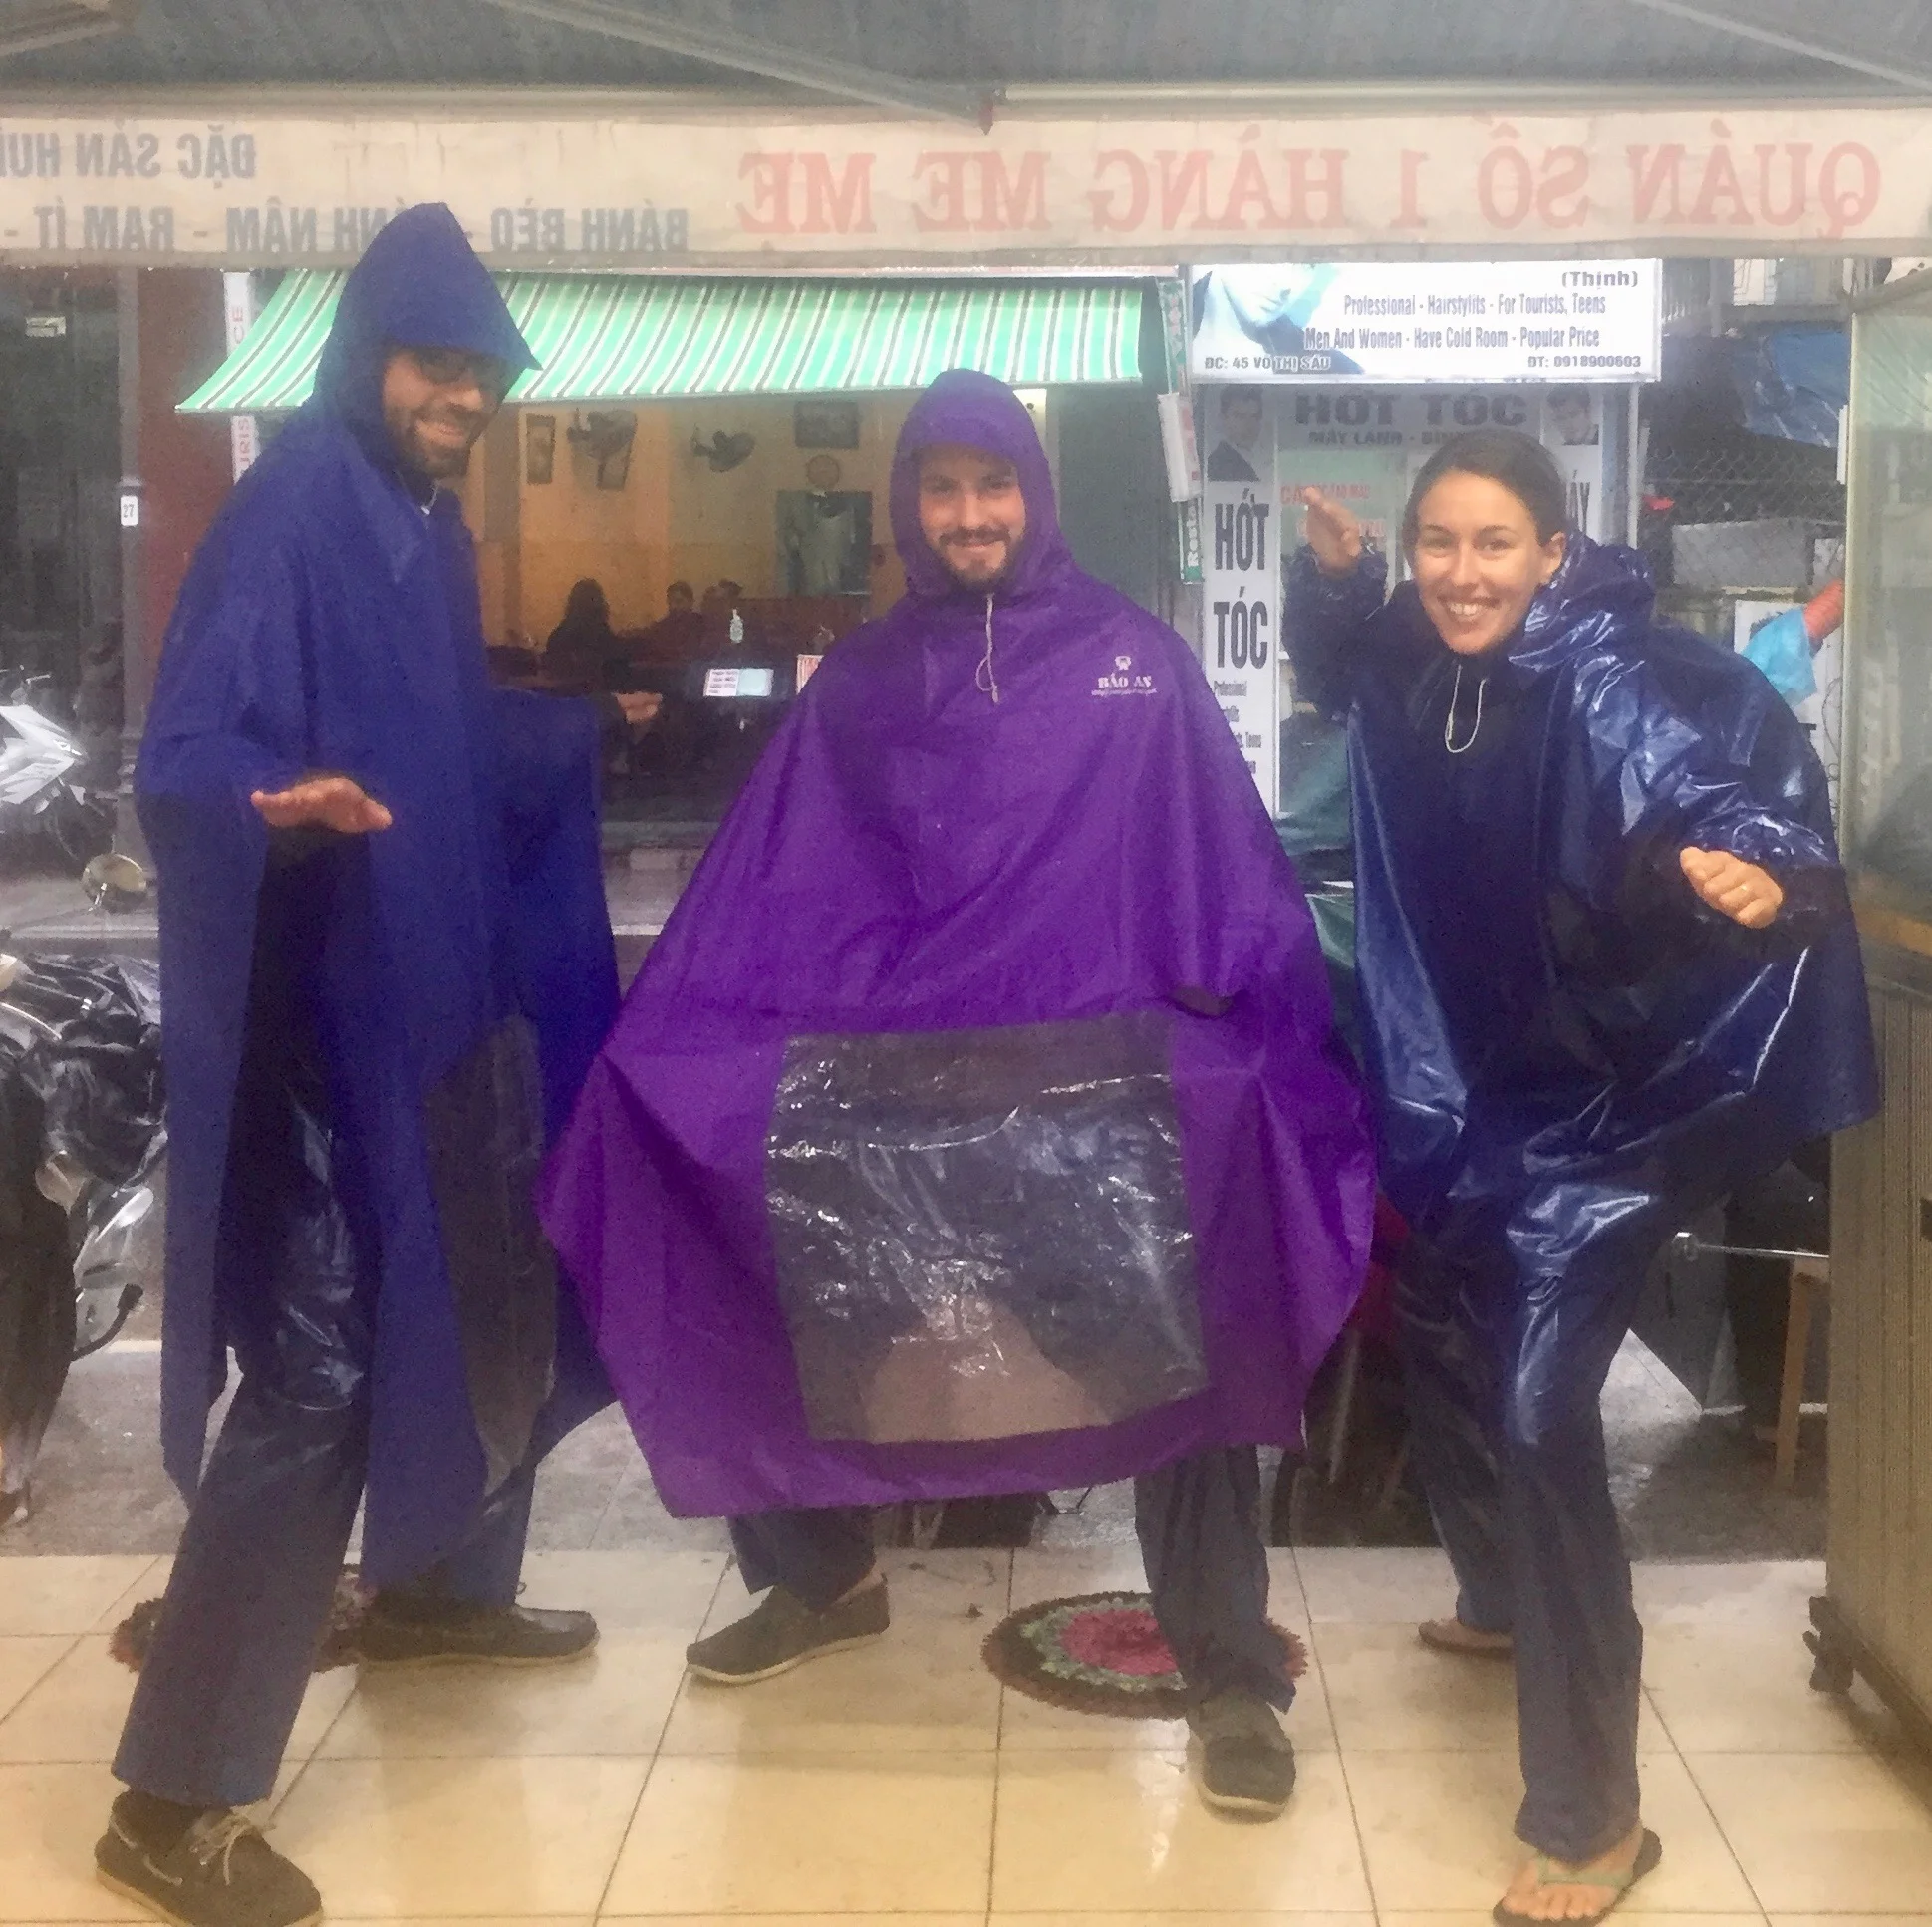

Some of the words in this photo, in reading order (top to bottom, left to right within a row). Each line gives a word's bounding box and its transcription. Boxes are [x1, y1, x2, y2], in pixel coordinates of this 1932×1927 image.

[1344, 295, 1416, 315] Professional
[1498, 294, 1516, 314] For
[1572, 293, 1606, 314] Teens
[1303, 328, 1330, 350] Men
[1333, 328, 1355, 349] And
[1358, 328, 1402, 349] Women
[1413, 328, 1442, 348] Have
[1446, 327, 1472, 348] Cold
[1475, 327, 1508, 348] Room
[1519, 327, 1565, 350] Popular
[1568, 326, 1600, 348] Price
[1204, 356, 1229, 370] ĐC:
[1232, 356, 1250, 370] 45
[1527, 355, 1550, 369] ĐT:
[1214, 487, 1270, 572] HỚT
[1213, 585, 1269, 670] TÓC
